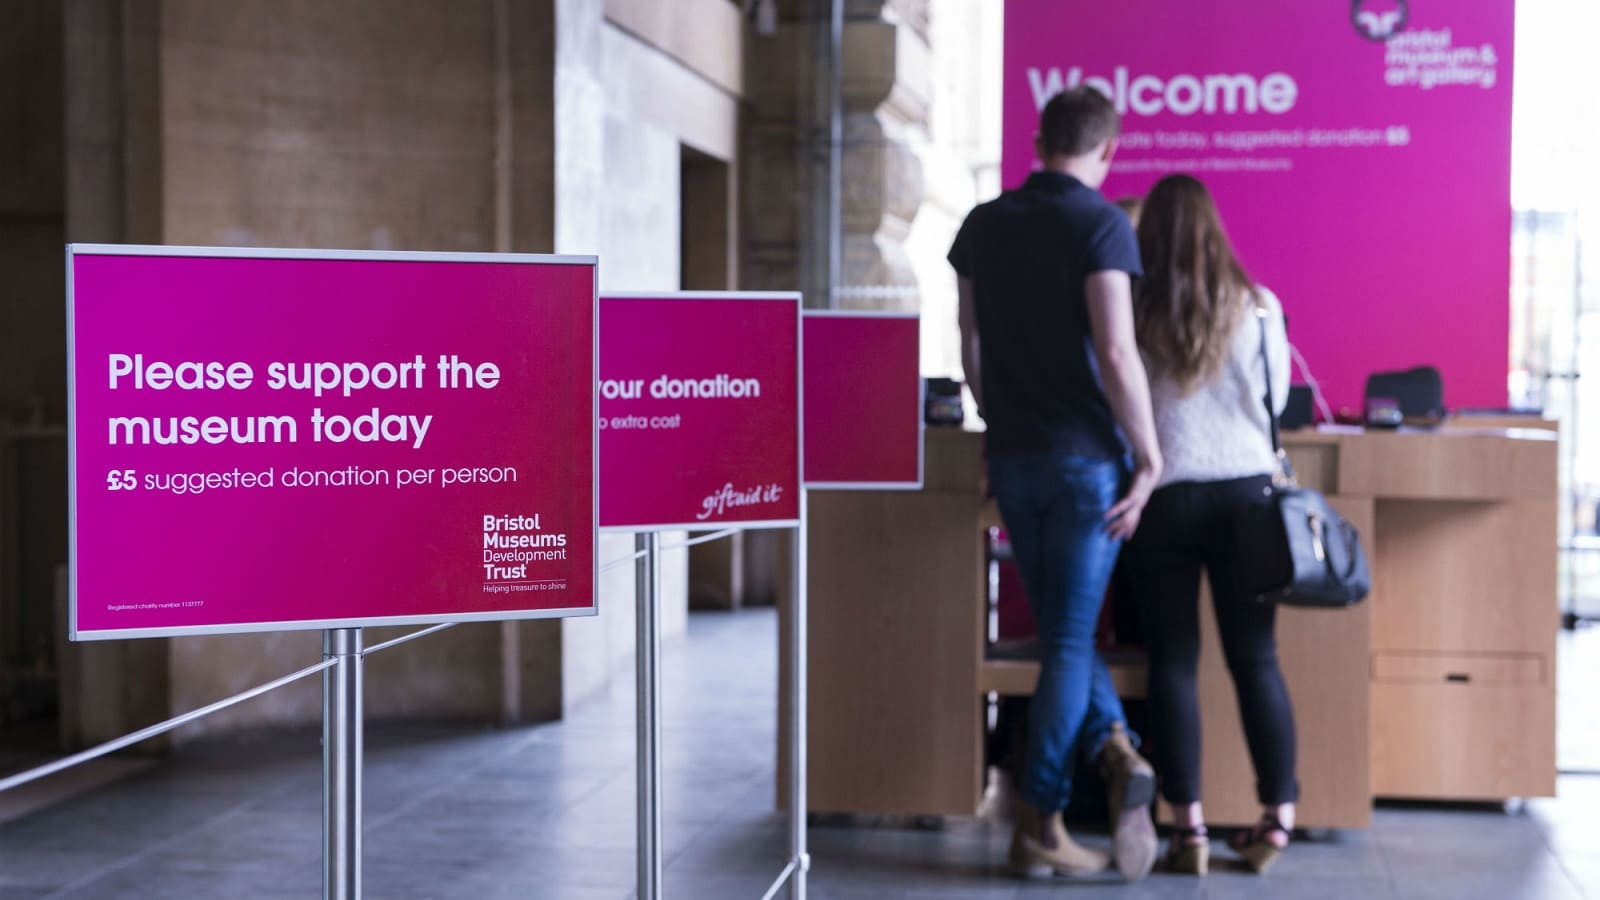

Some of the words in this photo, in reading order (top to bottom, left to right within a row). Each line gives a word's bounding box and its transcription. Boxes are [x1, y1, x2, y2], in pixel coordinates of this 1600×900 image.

[109, 354, 253, 390] Please
[267, 355, 426, 397] support
[437, 355, 500, 389] the
[650, 373, 761, 399] donation
[109, 414, 297, 445] museum
[311, 408, 433, 449] today
[611, 414, 649, 430] extra
[650, 413, 681, 429] cost
[106, 470, 138, 491] £5
[144, 467, 274, 495] suggested
[281, 466, 389, 488] donation
[397, 468, 435, 489] per
[442, 466, 517, 489] person
[483, 513, 541, 532] Bristol
[483, 532, 567, 549] Museums
[483, 548, 567, 564] Development
[483, 564, 527, 580] Trust
[483, 584, 510, 594] Helping
[510, 584, 539, 592] treasure
[548, 582, 566, 590] shine
